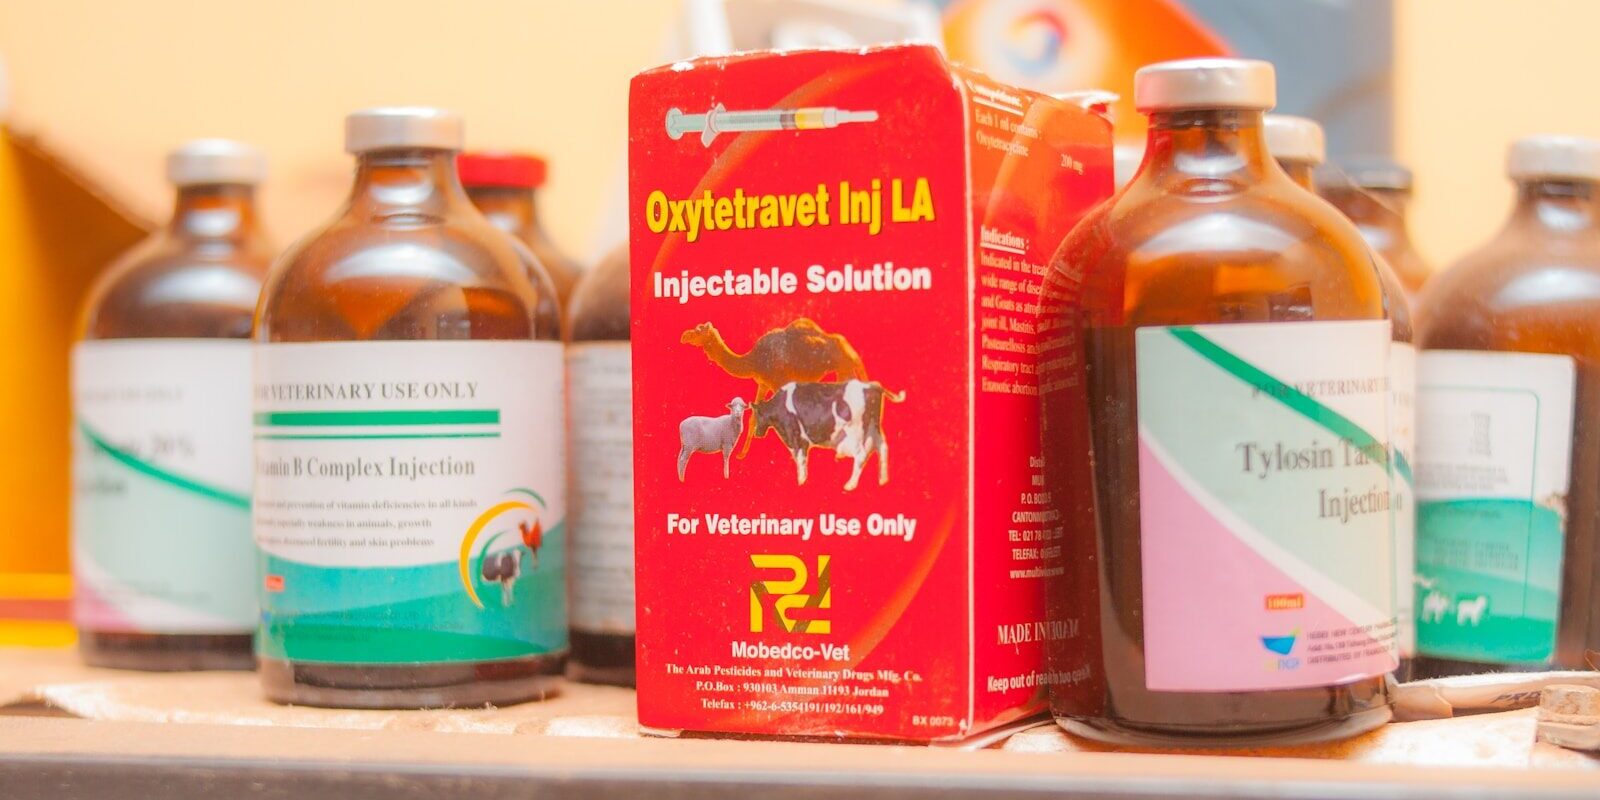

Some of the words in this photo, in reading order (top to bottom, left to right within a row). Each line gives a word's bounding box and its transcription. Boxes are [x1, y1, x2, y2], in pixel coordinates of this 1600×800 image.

[975, 108, 993, 127] Each
[646, 183, 831, 243] Oxytetravet
[839, 178, 882, 236] Inj
[891, 177, 937, 223] LA
[981, 252, 1012, 271] Indicated
[1020, 259, 1031, 275] the
[653, 267, 798, 304] Injectable
[806, 262, 932, 294] Solution
[981, 353, 1019, 377] Respiratory
[271, 382, 372, 399] VETERINARY
[381, 382, 419, 399] USE
[424, 382, 478, 398] ONLY
[294, 456, 303, 476] B
[307, 456, 382, 481] Complex
[390, 455, 475, 480] Injection
[1236, 441, 1332, 480] Tylosin
[337, 500, 371, 509] vitamin
[372, 499, 425, 509] deficiencies
[428, 499, 437, 508] in
[440, 499, 451, 508] all
[452, 499, 478, 508] kinds
[1319, 485, 1390, 524] Injection
[398, 518, 432, 529] growth
[667, 513, 699, 535] For
[705, 513, 813, 541] Veterinary
[819, 513, 861, 536] Use
[867, 513, 917, 541] Only
[349, 537, 366, 547] and
[369, 536, 388, 547] skin
[390, 537, 434, 549] problems
[997, 623, 1032, 645] MADE
[731, 641, 850, 661] Mobedco-Vet
[666, 663, 684, 674] The
[686, 664, 711, 676] Arab
[714, 665, 761, 677] Pesticides
[764, 667, 783, 678] and
[786, 668, 840, 682] Veterinary
[842, 669, 874, 682] Drugs
[903, 670, 923, 682] Co.
[987, 675, 1009, 694] Keep
[1009, 675, 1025, 690] out
[1026, 670, 1036, 687] of
[695, 681, 734, 692] P.O.Box
[852, 686, 889, 697] Jordan
[701, 698, 735, 709] Telefax
[913, 715, 927, 725] BX
